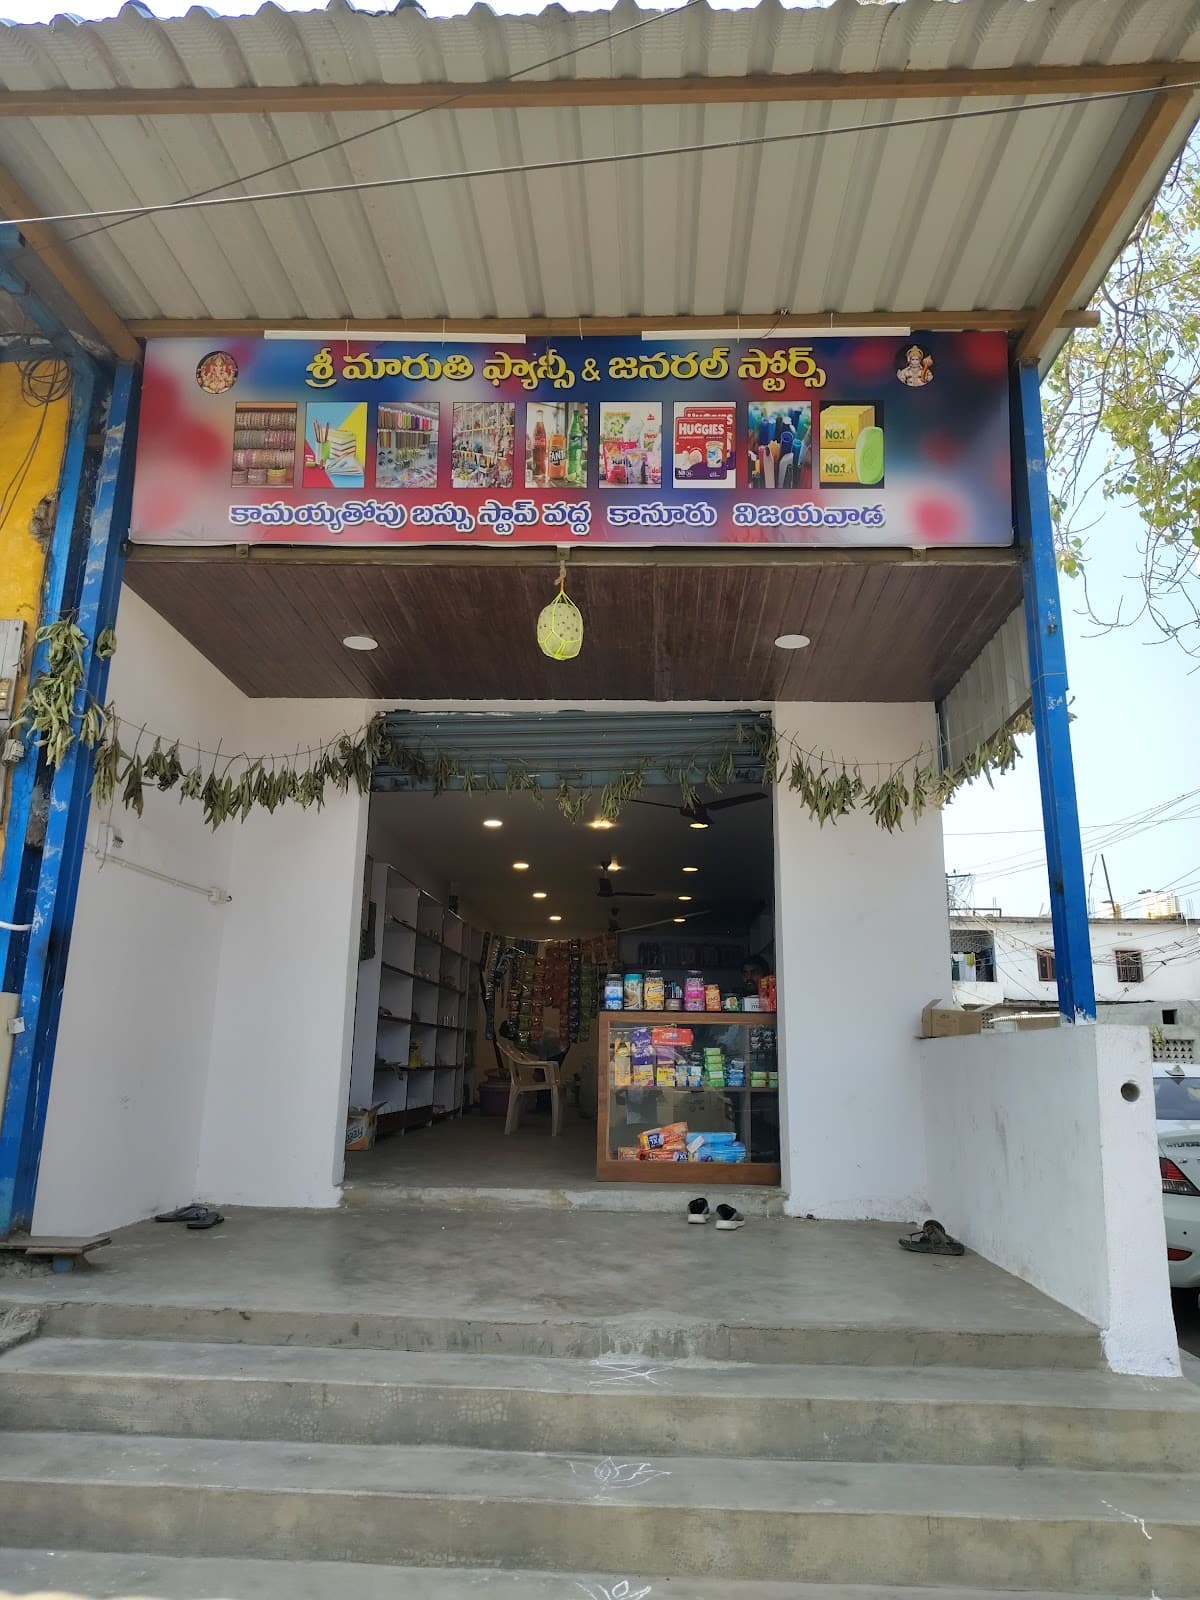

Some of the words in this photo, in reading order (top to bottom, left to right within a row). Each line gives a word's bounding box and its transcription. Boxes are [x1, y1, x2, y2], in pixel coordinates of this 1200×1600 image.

[305, 347, 337, 389] శ్రీ
[342, 352, 474, 381] మారుతి
[482, 349, 576, 391] ఫ్యాన్సీ
[581, 358, 601, 382] &
[607, 347, 730, 380] జనరల్
[737, 347, 827, 392] స్టోర్స్
[678, 423, 725, 436] HUGGIES
[229, 499, 407, 533] కామయ్యతోపు
[411, 502, 475, 533] బస్సు
[479, 499, 542, 535] స్టాప్
[542, 501, 592, 535] వద్ద
[607, 501, 718, 527] కానూరు
[733, 502, 886, 527] విజయవాడ
